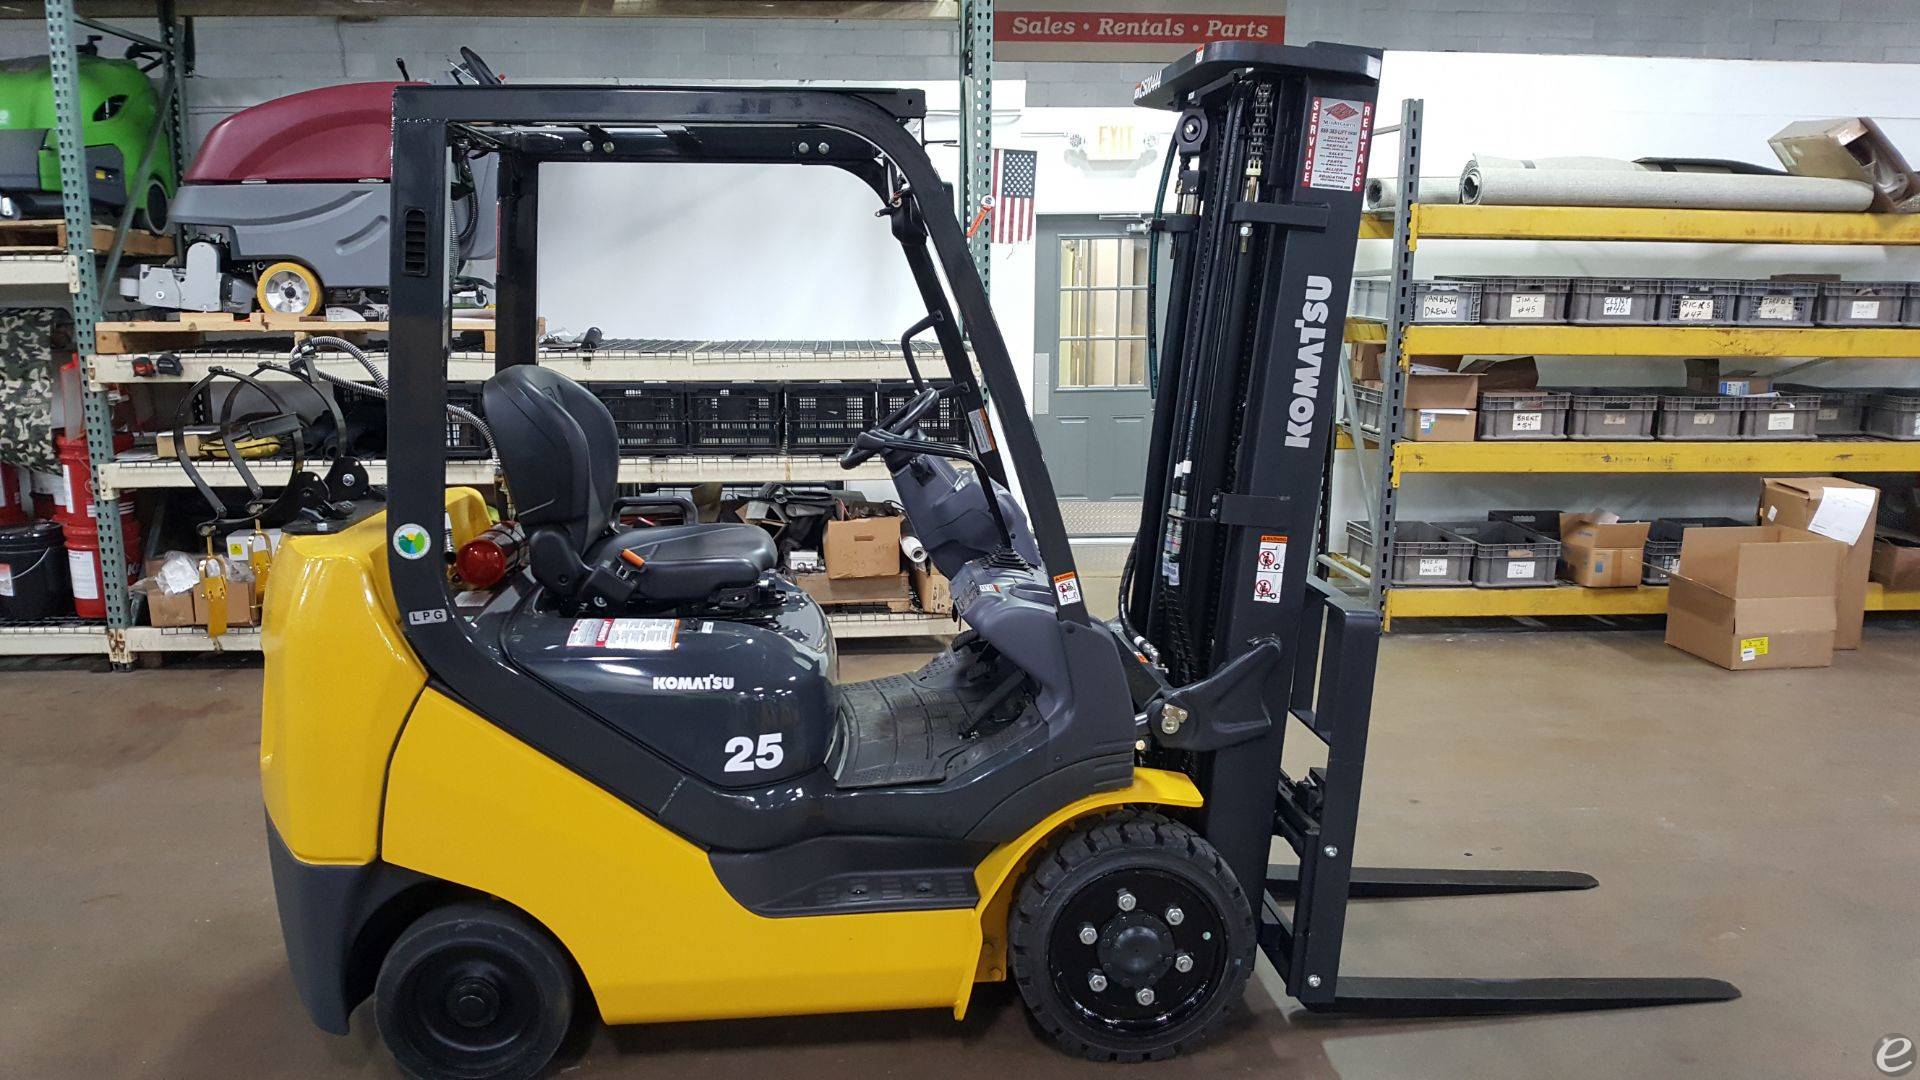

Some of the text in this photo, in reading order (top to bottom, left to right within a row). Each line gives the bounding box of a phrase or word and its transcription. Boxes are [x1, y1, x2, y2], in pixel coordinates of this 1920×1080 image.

[1012, 16, 1269, 38] Sales Rentals Parts
[1303, 101, 1319, 182] SERVICE
[1354, 106, 1371, 187] RENTALS
[1284, 275, 1332, 448] KOMATSU
[412, 610, 443, 622] LPG
[652, 673, 735, 690] KOMATSU
[724, 732, 784, 772] 25
